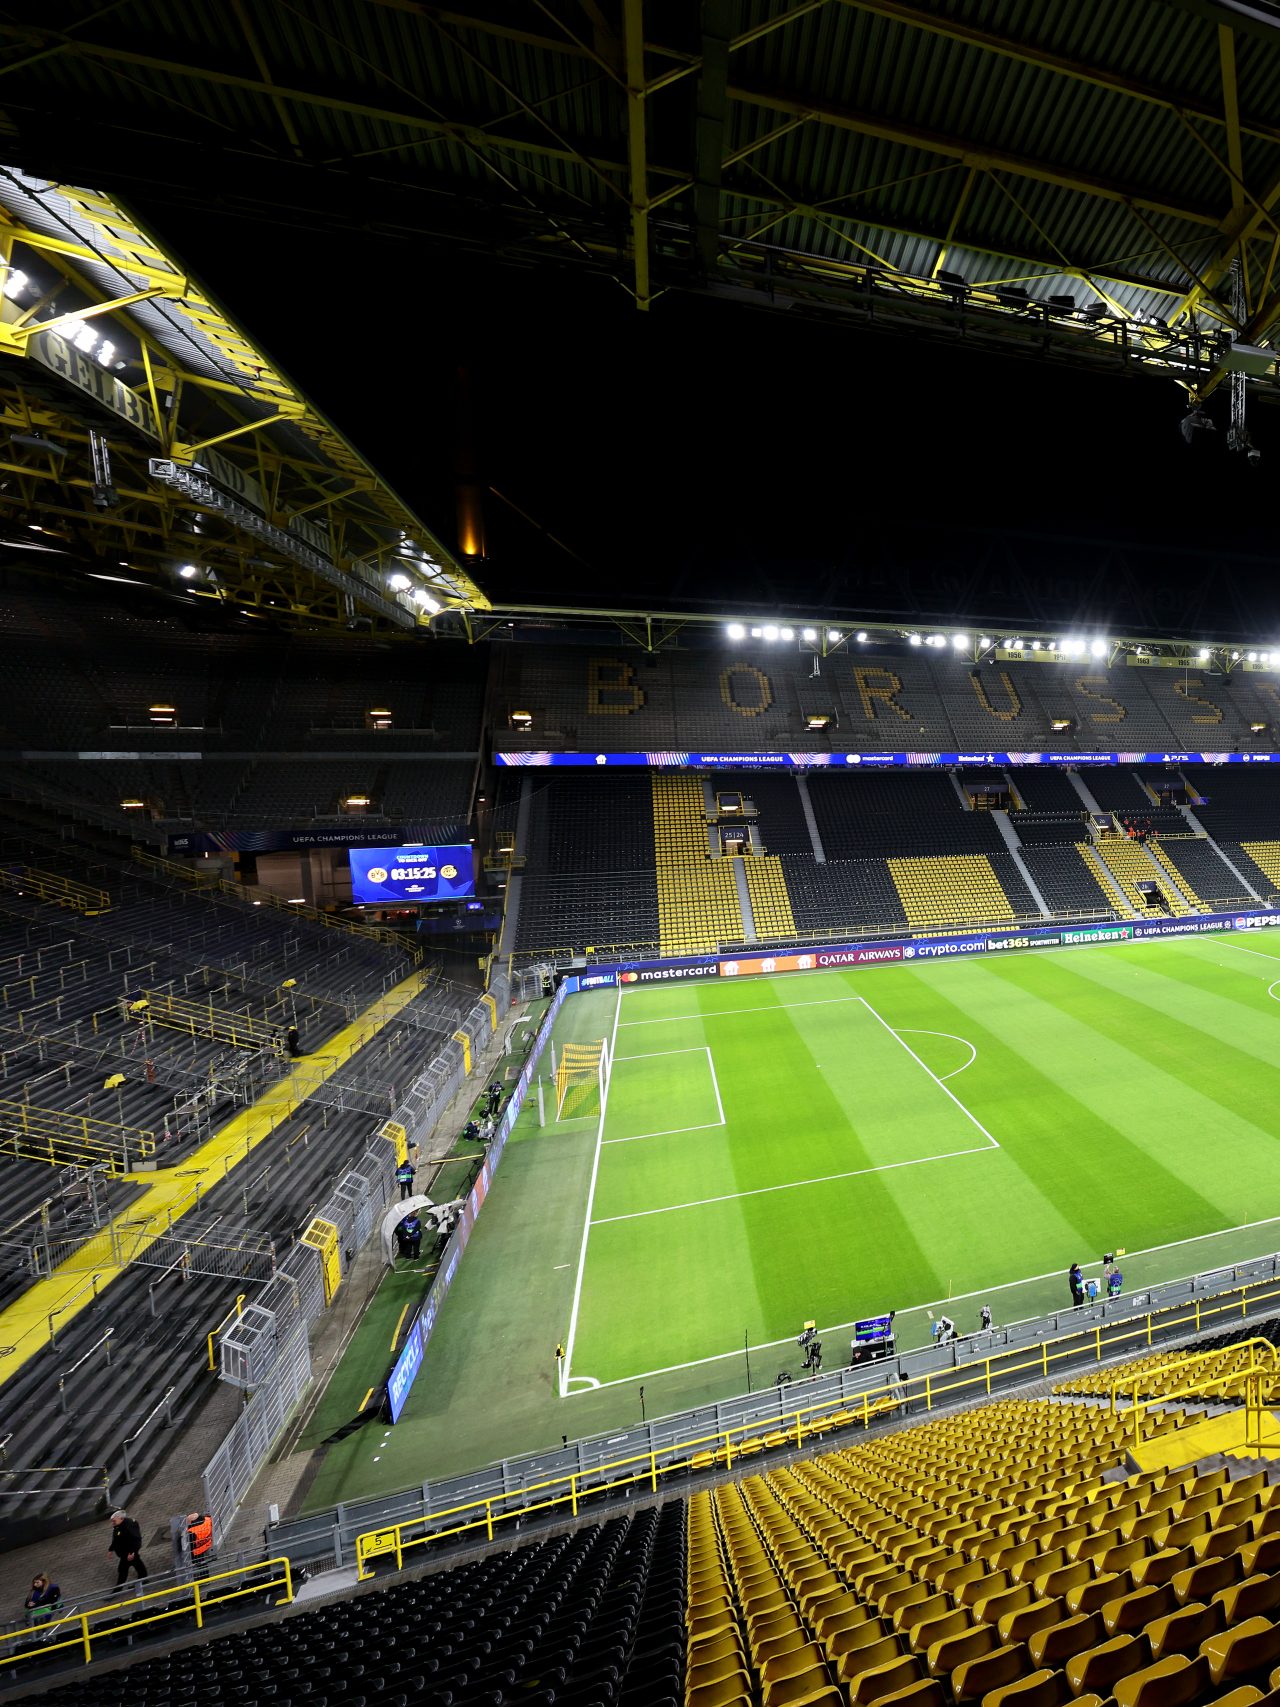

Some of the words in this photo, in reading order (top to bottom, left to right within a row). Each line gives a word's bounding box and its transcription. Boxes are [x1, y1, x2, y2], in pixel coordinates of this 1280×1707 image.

[391, 867, 436, 880] 03:15:25
[1162, 924, 1198, 933] CHAMPIONS
[1199, 921, 1223, 931] LEAGUE
[1246, 915, 1280, 927] PEPSI
[988, 938, 1029, 950] bet365
[1064, 931, 1119, 944] Heineken
[918, 942, 985, 956] crypto.com
[819, 954, 855, 965] QATAR
[858, 949, 900, 961] AIRWAYS
[641, 965, 717, 980] mastercard
[392, 1335, 419, 1405] RECYCLE
[375, 1537, 382, 1546] 5
